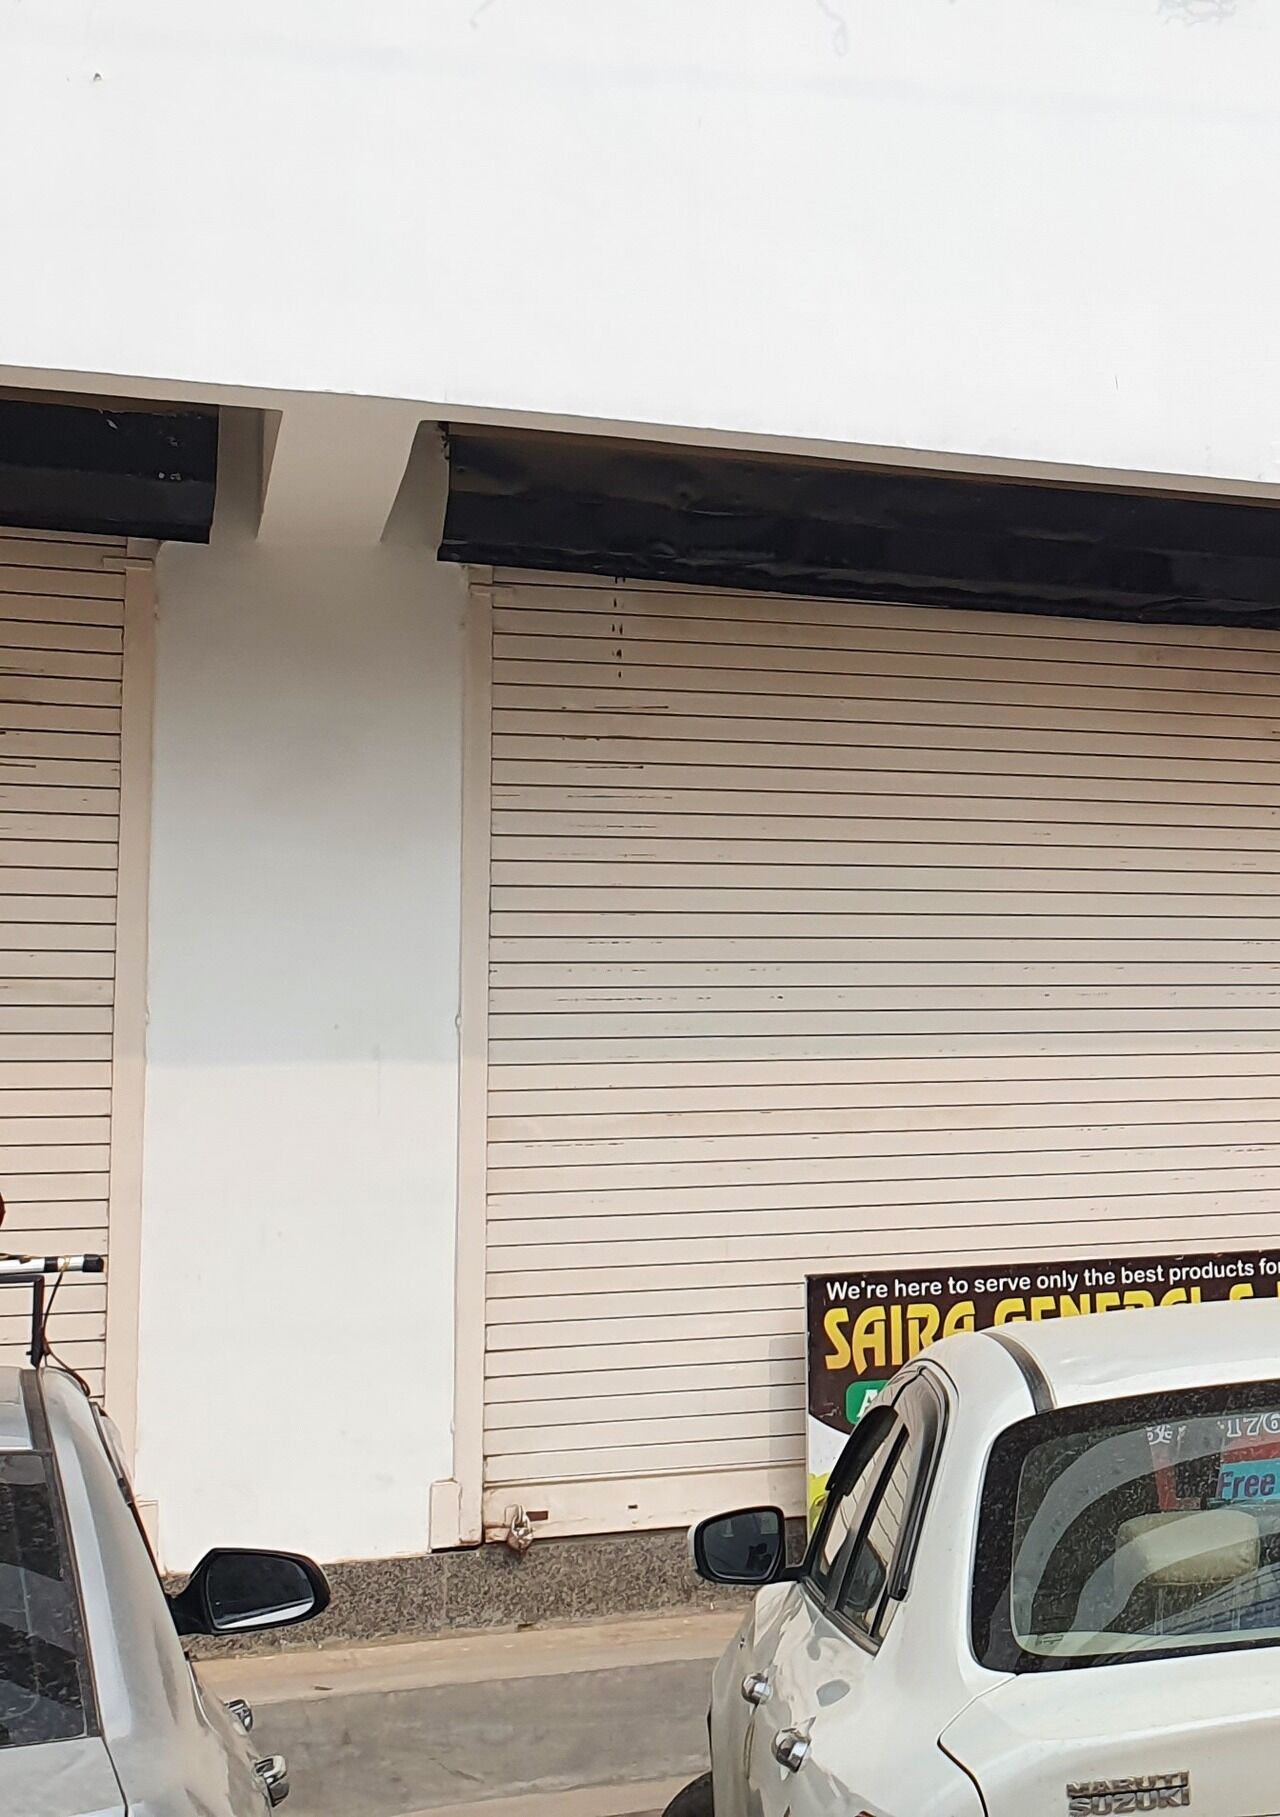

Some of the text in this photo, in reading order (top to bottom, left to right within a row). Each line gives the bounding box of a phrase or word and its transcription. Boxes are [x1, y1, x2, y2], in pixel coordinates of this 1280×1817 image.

[826, 1280, 888, 1302] We're
[894, 1278, 942, 1300] here
[948, 1276, 969, 1295] to
[974, 1275, 1031, 1295] serve
[1036, 1269, 1079, 1296] only
[1083, 1266, 1113, 1287] the
[1121, 1264, 1165, 1285] best
[1169, 1257, 1255, 1289] products
[1217, 1470, 1275, 1500] Free
[1066, 1768, 1191, 1798] MARUTI
[1068, 1786, 1192, 1817] SUZUKI
